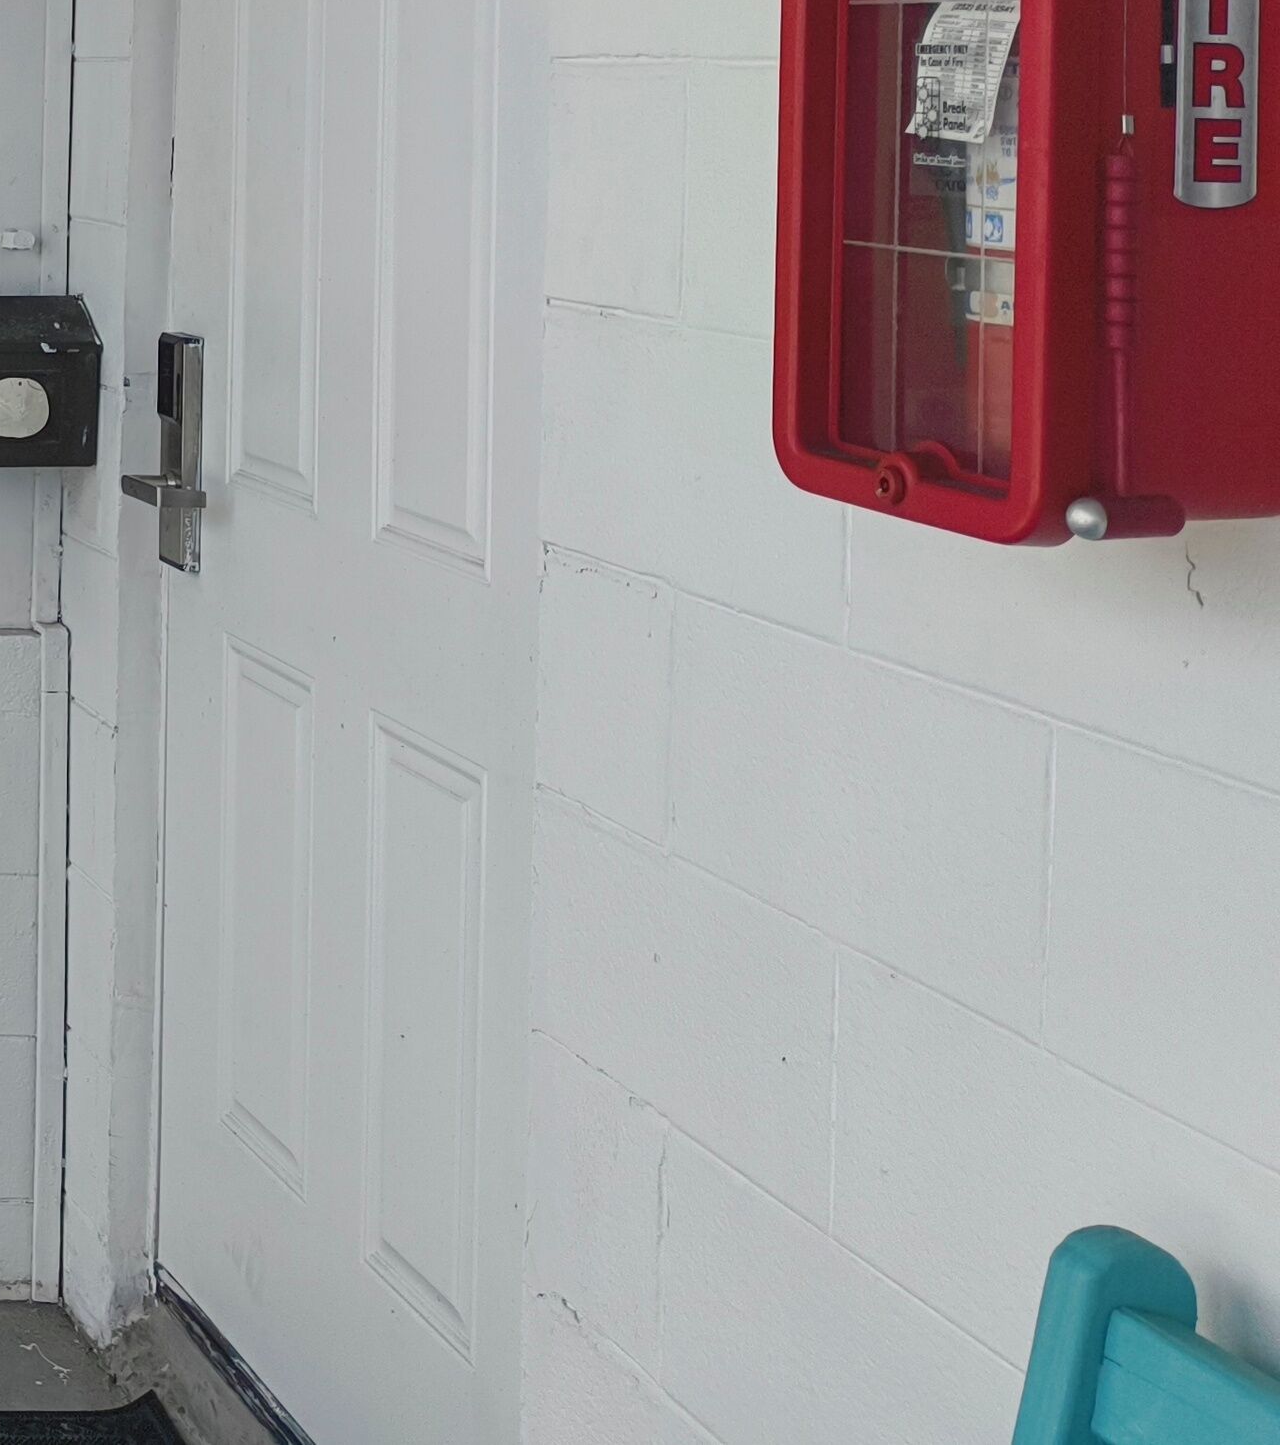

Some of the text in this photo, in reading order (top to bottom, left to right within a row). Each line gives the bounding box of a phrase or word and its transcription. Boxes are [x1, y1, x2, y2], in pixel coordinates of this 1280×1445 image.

[928, 56, 942, 66] Case
[944, 56, 951, 66] of
[942, 100, 966, 113] Break
[943, 116, 966, 131] Panel
